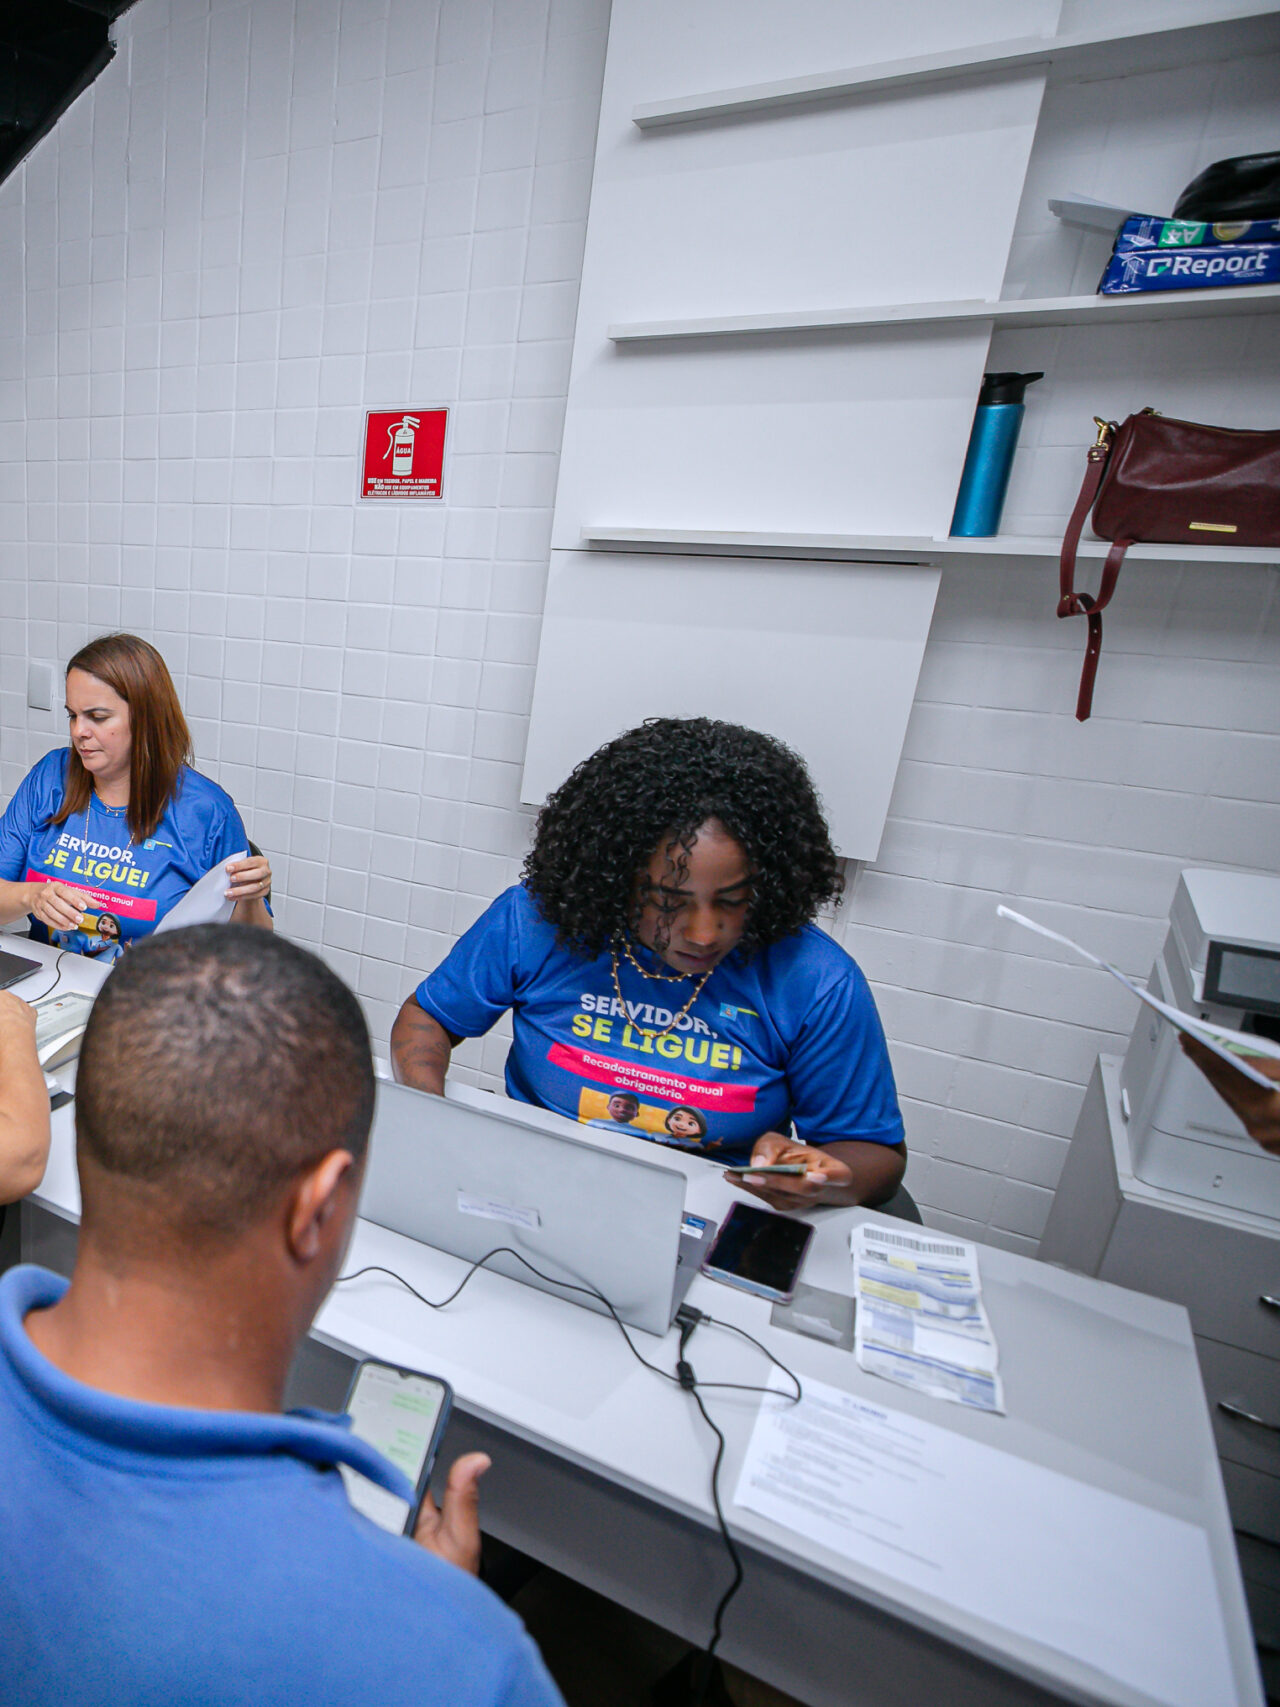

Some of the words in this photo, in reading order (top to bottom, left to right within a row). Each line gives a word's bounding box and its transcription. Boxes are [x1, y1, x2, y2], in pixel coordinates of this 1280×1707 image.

[1172, 251, 1269, 278] Report
[396, 446, 411, 454] ÁGUA
[56, 832, 137, 867] ERVIDOR,
[72, 856, 150, 888] LIGUE!
[111, 895, 134, 907] anual
[580, 993, 718, 1039] SERVIDOR,
[572, 1014, 614, 1042] SE
[622, 1025, 743, 1070] LIGUE!
[582, 1055, 687, 1089] Recadastramento
[689, 1083, 724, 1097] anual
[615, 1075, 685, 1101] obrigatório.
